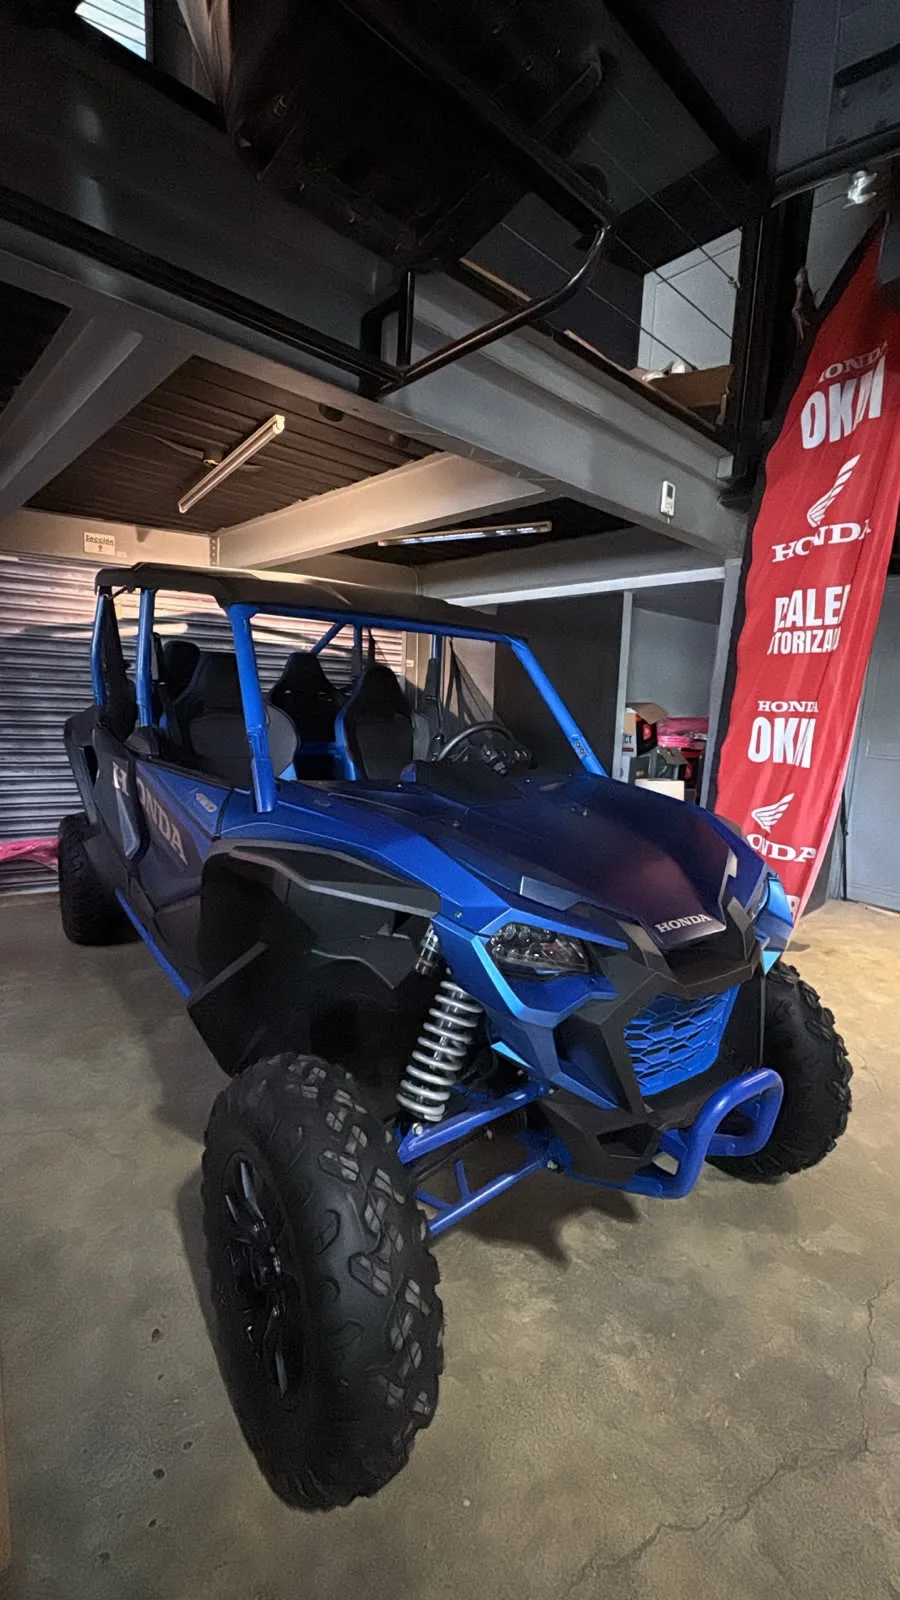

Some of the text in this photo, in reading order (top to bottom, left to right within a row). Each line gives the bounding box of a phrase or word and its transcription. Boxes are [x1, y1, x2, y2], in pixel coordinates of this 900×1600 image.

[112, 761, 189, 866] HONDA
[746, 833, 818, 863] ONDA
[654, 913, 713, 933] HONDA
